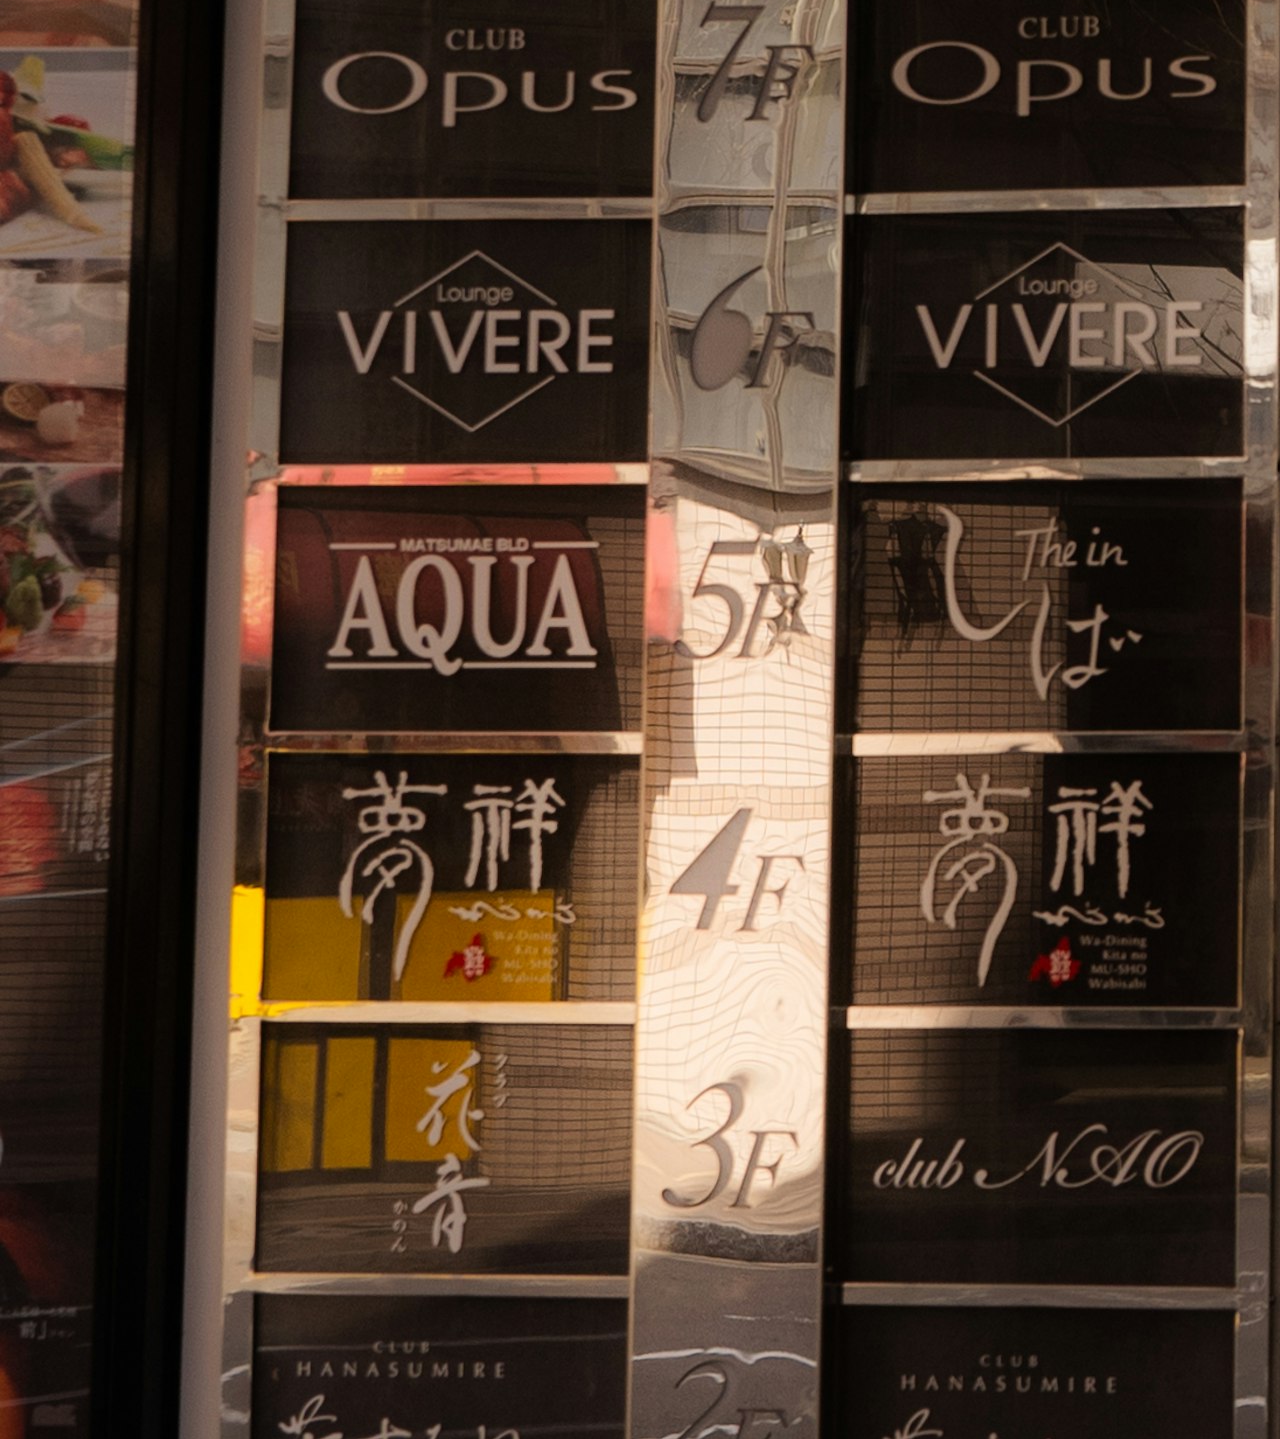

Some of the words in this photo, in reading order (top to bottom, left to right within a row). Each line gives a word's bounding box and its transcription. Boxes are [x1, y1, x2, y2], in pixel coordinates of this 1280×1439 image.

[446, 28, 527, 51] CLUB
[1018, 16, 1101, 39] CLUB
[697, 0, 815, 123] 7F
[436, 283, 514, 307] Lounge
[1018, 274, 1098, 298] Lounge
[691, 266, 817, 392] 6F
[915, 300, 1204, 370] VIVERE
[337, 309, 615, 374] VIVERE
[400, 538, 493, 552] MATSUMAE
[496, 538, 530, 552] BLD
[1015, 516, 1077, 581] The
[674, 535, 802, 659] 5F
[327, 553, 598, 676] AQUA
[670, 808, 804, 932] 4F
[1079, 935, 1148, 949] Wa-Dining
[1103, 950, 1128, 961] Kita
[1131, 952, 1148, 961] no
[1090, 963, 1147, 975] MU-SHO
[1088, 977, 1147, 990] Wabisabi
[662, 1082, 799, 1209] 3F
[874, 1136, 964, 1191] club
[975, 1123, 1205, 1191] NAO
[372, 1340, 430, 1354] CLUB
[296, 1361, 506, 1379] HANASUMIRE
[979, 1353, 1038, 1368] CLUB
[900, 1374, 1118, 1394] HANASUMIRE
